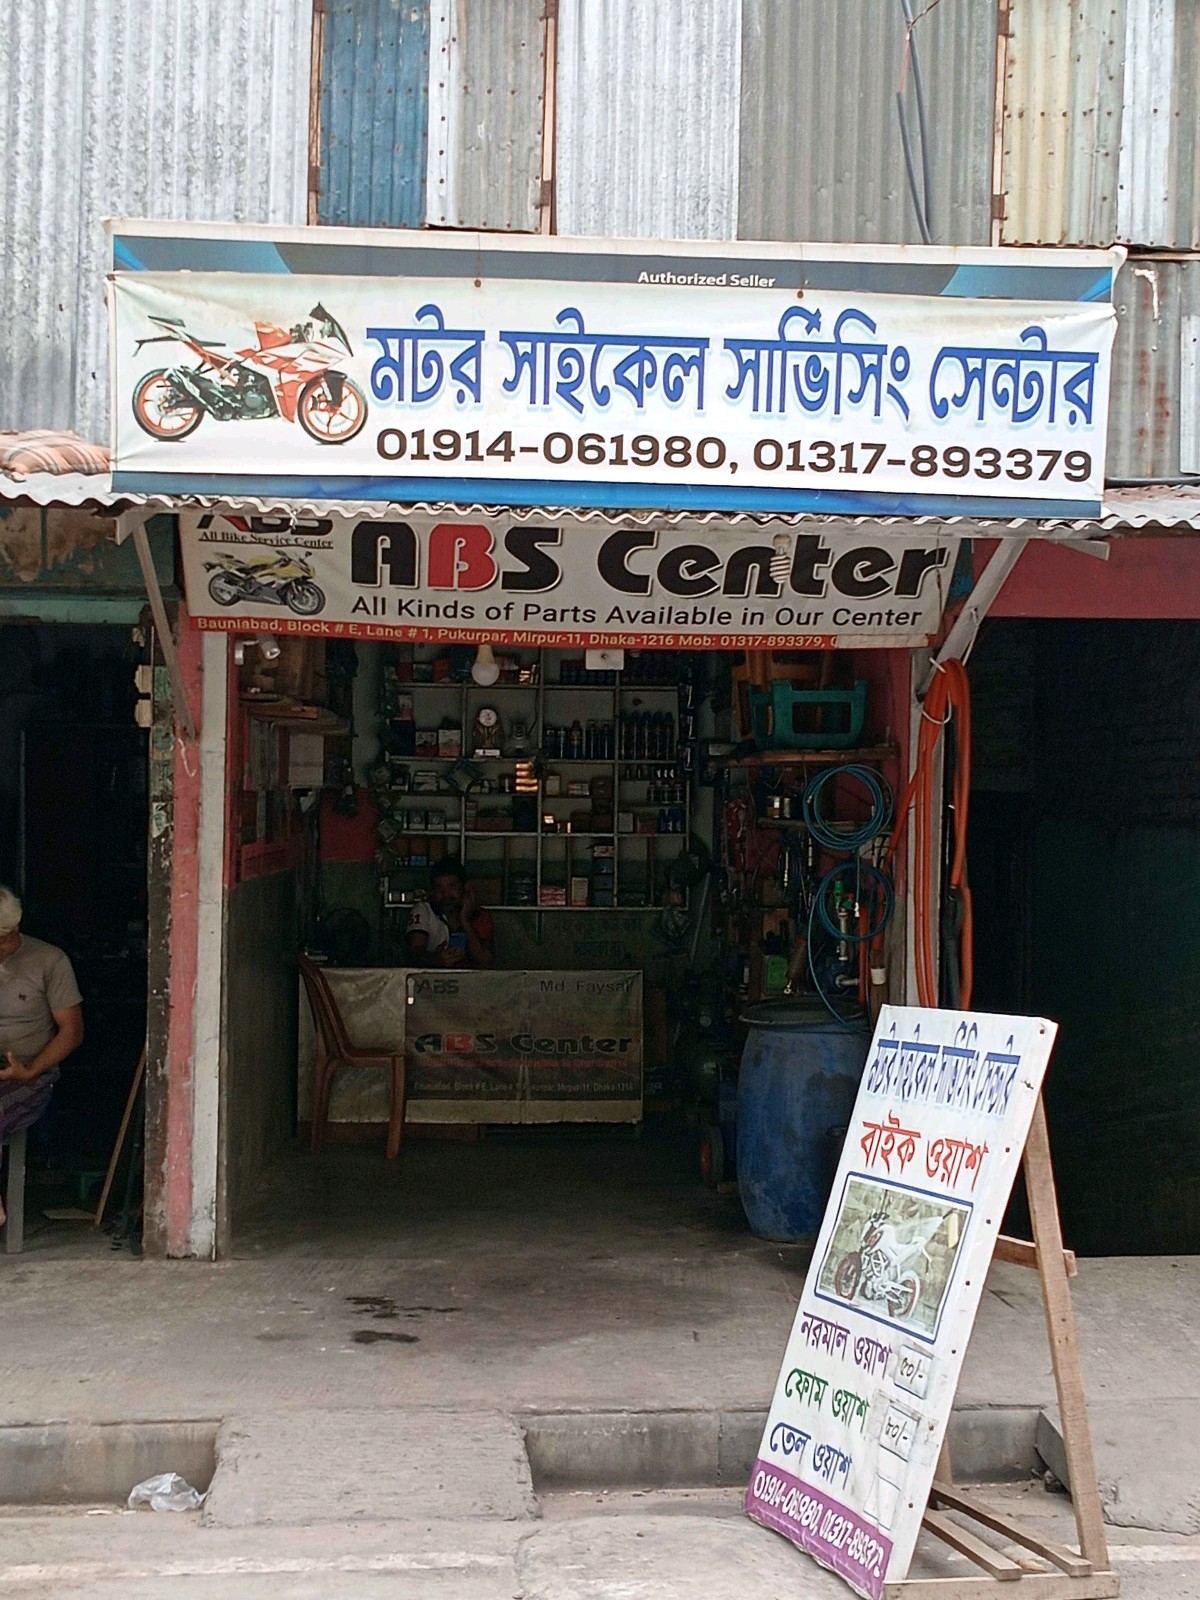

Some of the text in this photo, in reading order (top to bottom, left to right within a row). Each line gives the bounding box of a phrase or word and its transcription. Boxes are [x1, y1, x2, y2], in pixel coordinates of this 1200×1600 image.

[637, 270, 776, 288] Authorized Seller
[366, 303, 1100, 426] মটর সাইকেল সার্ভিসিং সেন্টার
[376, 427, 1092, 483] 01914-061980, 01317-893379
[200, 531, 334, 548] All Bike Service Center
[350, 520, 949, 599] ABS Center
[287, 619, 330, 634] Block
[334, 623, 344, 634] #
[348, 624, 362, 636] E,
[366, 625, 403, 638] Lane
[407, 628, 418, 639] #
[421, 628, 434, 641] 1,
[437, 628, 509, 646] Pukurpar,
[512, 631, 585, 647] Mirpur-11,
[588, 633, 675, 647] Dhaka-1216
[678, 635, 716, 647] Mob:
[720, 635, 826, 648] 01317-893379,
[351, 596, 923, 627] All Kinds of Parts Available in Our Center
[414, 1033, 633, 1055] ABS Center
[860, 1109, 989, 1192] বাইক ওয়াশ
[801, 1311, 892, 1380] নরমাল ওয়াশ
[785, 1367, 870, 1434] ফোম ওয়াশ
[770, 1422, 852, 1491] তেল ওয়াশ
